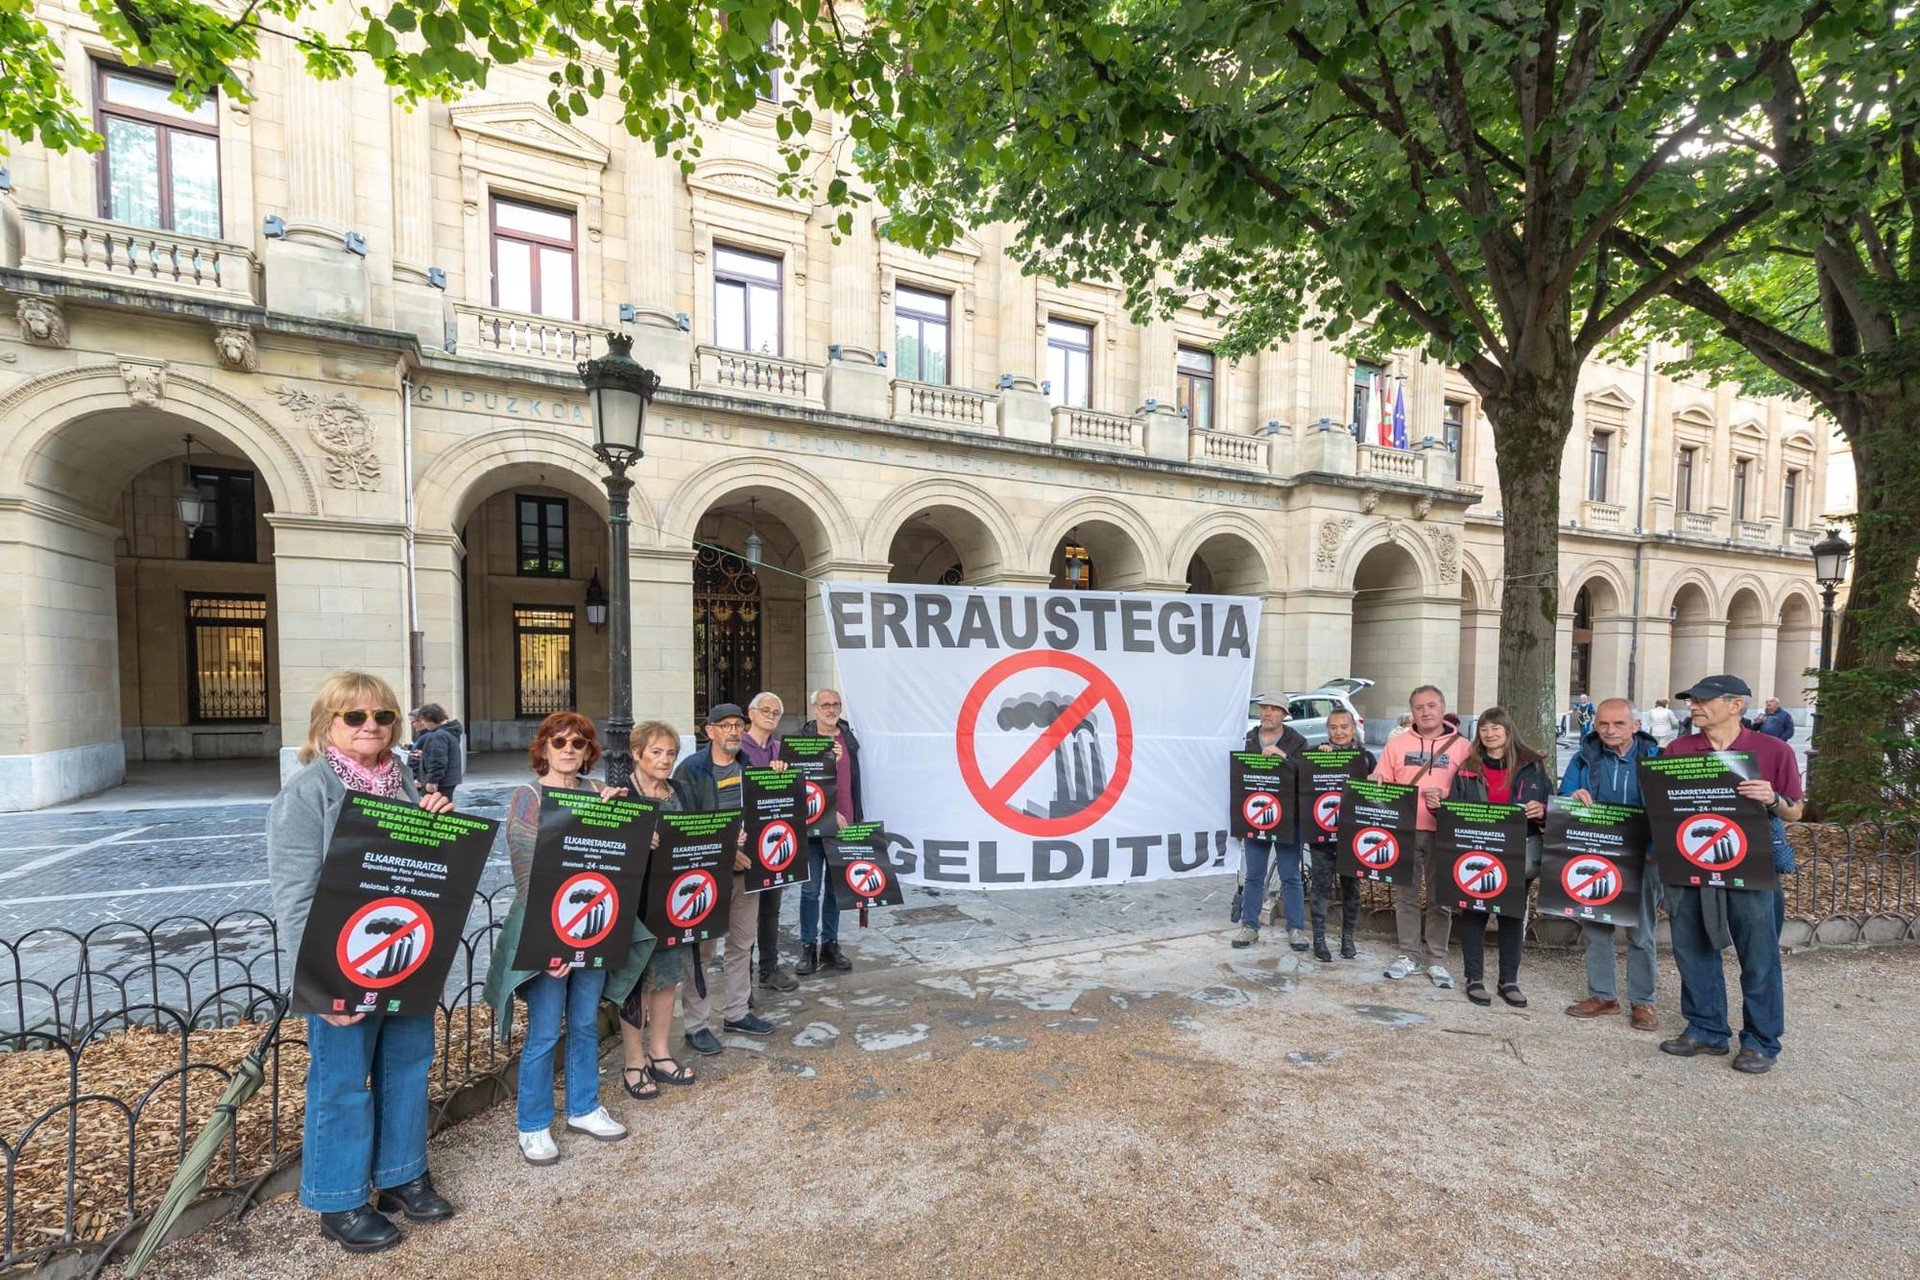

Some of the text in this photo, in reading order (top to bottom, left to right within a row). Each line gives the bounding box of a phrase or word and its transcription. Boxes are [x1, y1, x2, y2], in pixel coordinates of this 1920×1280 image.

[417, 385, 585, 422] GIPUZKOA
[662, 417, 734, 441] FORU
[829, 591, 1251, 659] ERRAUSTEGIA
[352, 797, 490, 831] ERRAUSTEGIAK EGUNERO
[362, 808, 470, 836] KUTSATZEN GAITU.
[377, 821, 457, 842] ERRAUSTEGIA
[389, 832, 440, 848] GELDITU!
[563, 836, 627, 850] ELKARRETARATZEA
[364, 852, 448, 874] ELKARRETARATZEA
[885, 829, 1228, 884] GELDITU!
